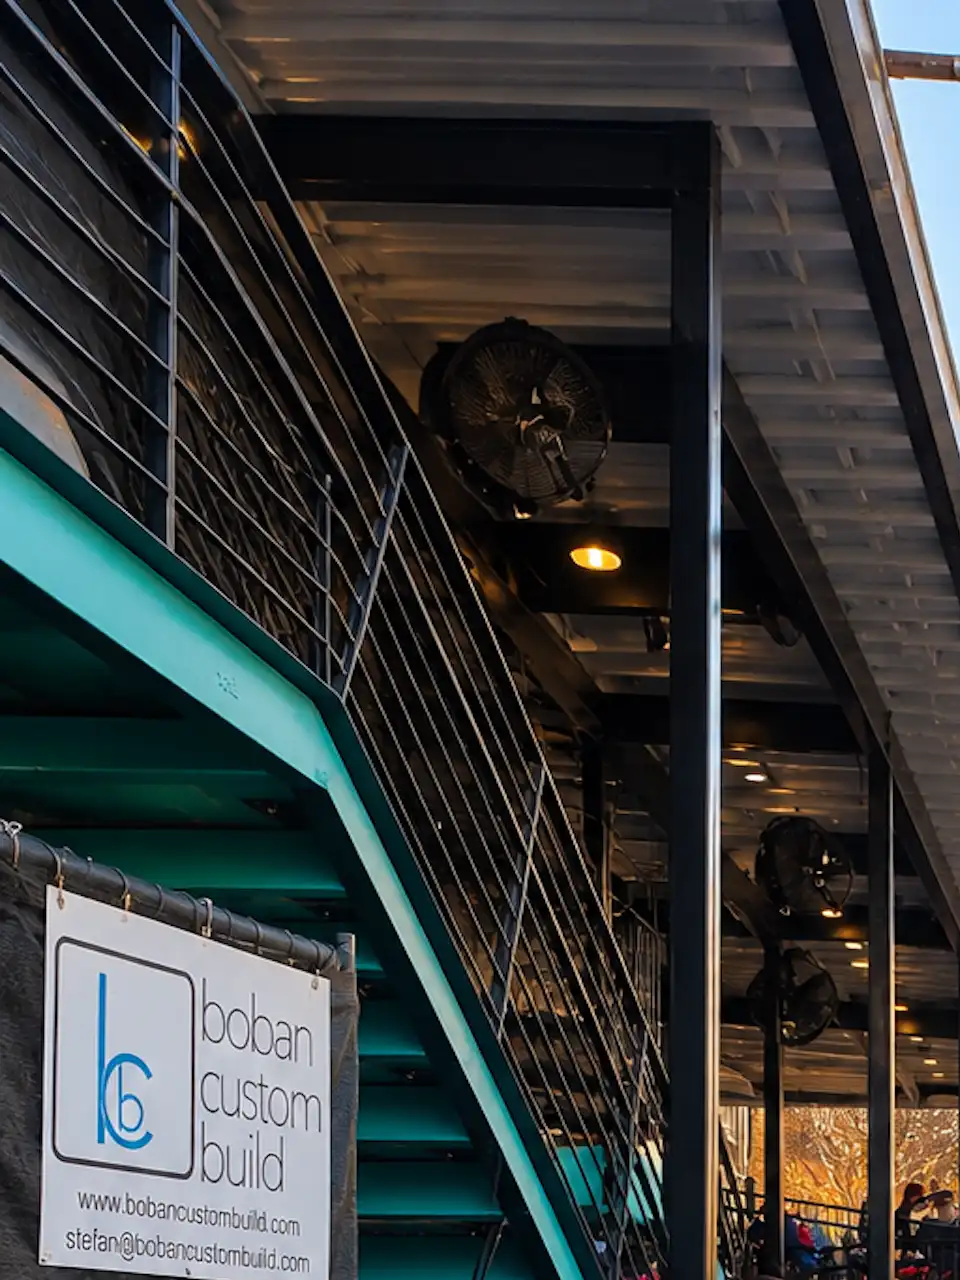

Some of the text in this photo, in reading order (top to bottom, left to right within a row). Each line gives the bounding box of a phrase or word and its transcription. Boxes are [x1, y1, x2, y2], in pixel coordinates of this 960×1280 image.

[202, 977, 313, 1067] boban
[200, 1071, 322, 1133] custom
[201, 1120, 284, 1193] build
[77, 1191, 301, 1237] www.bobancustombuild.com
[65, 1227, 311, 1273] stefan@bobancustombuild.com
